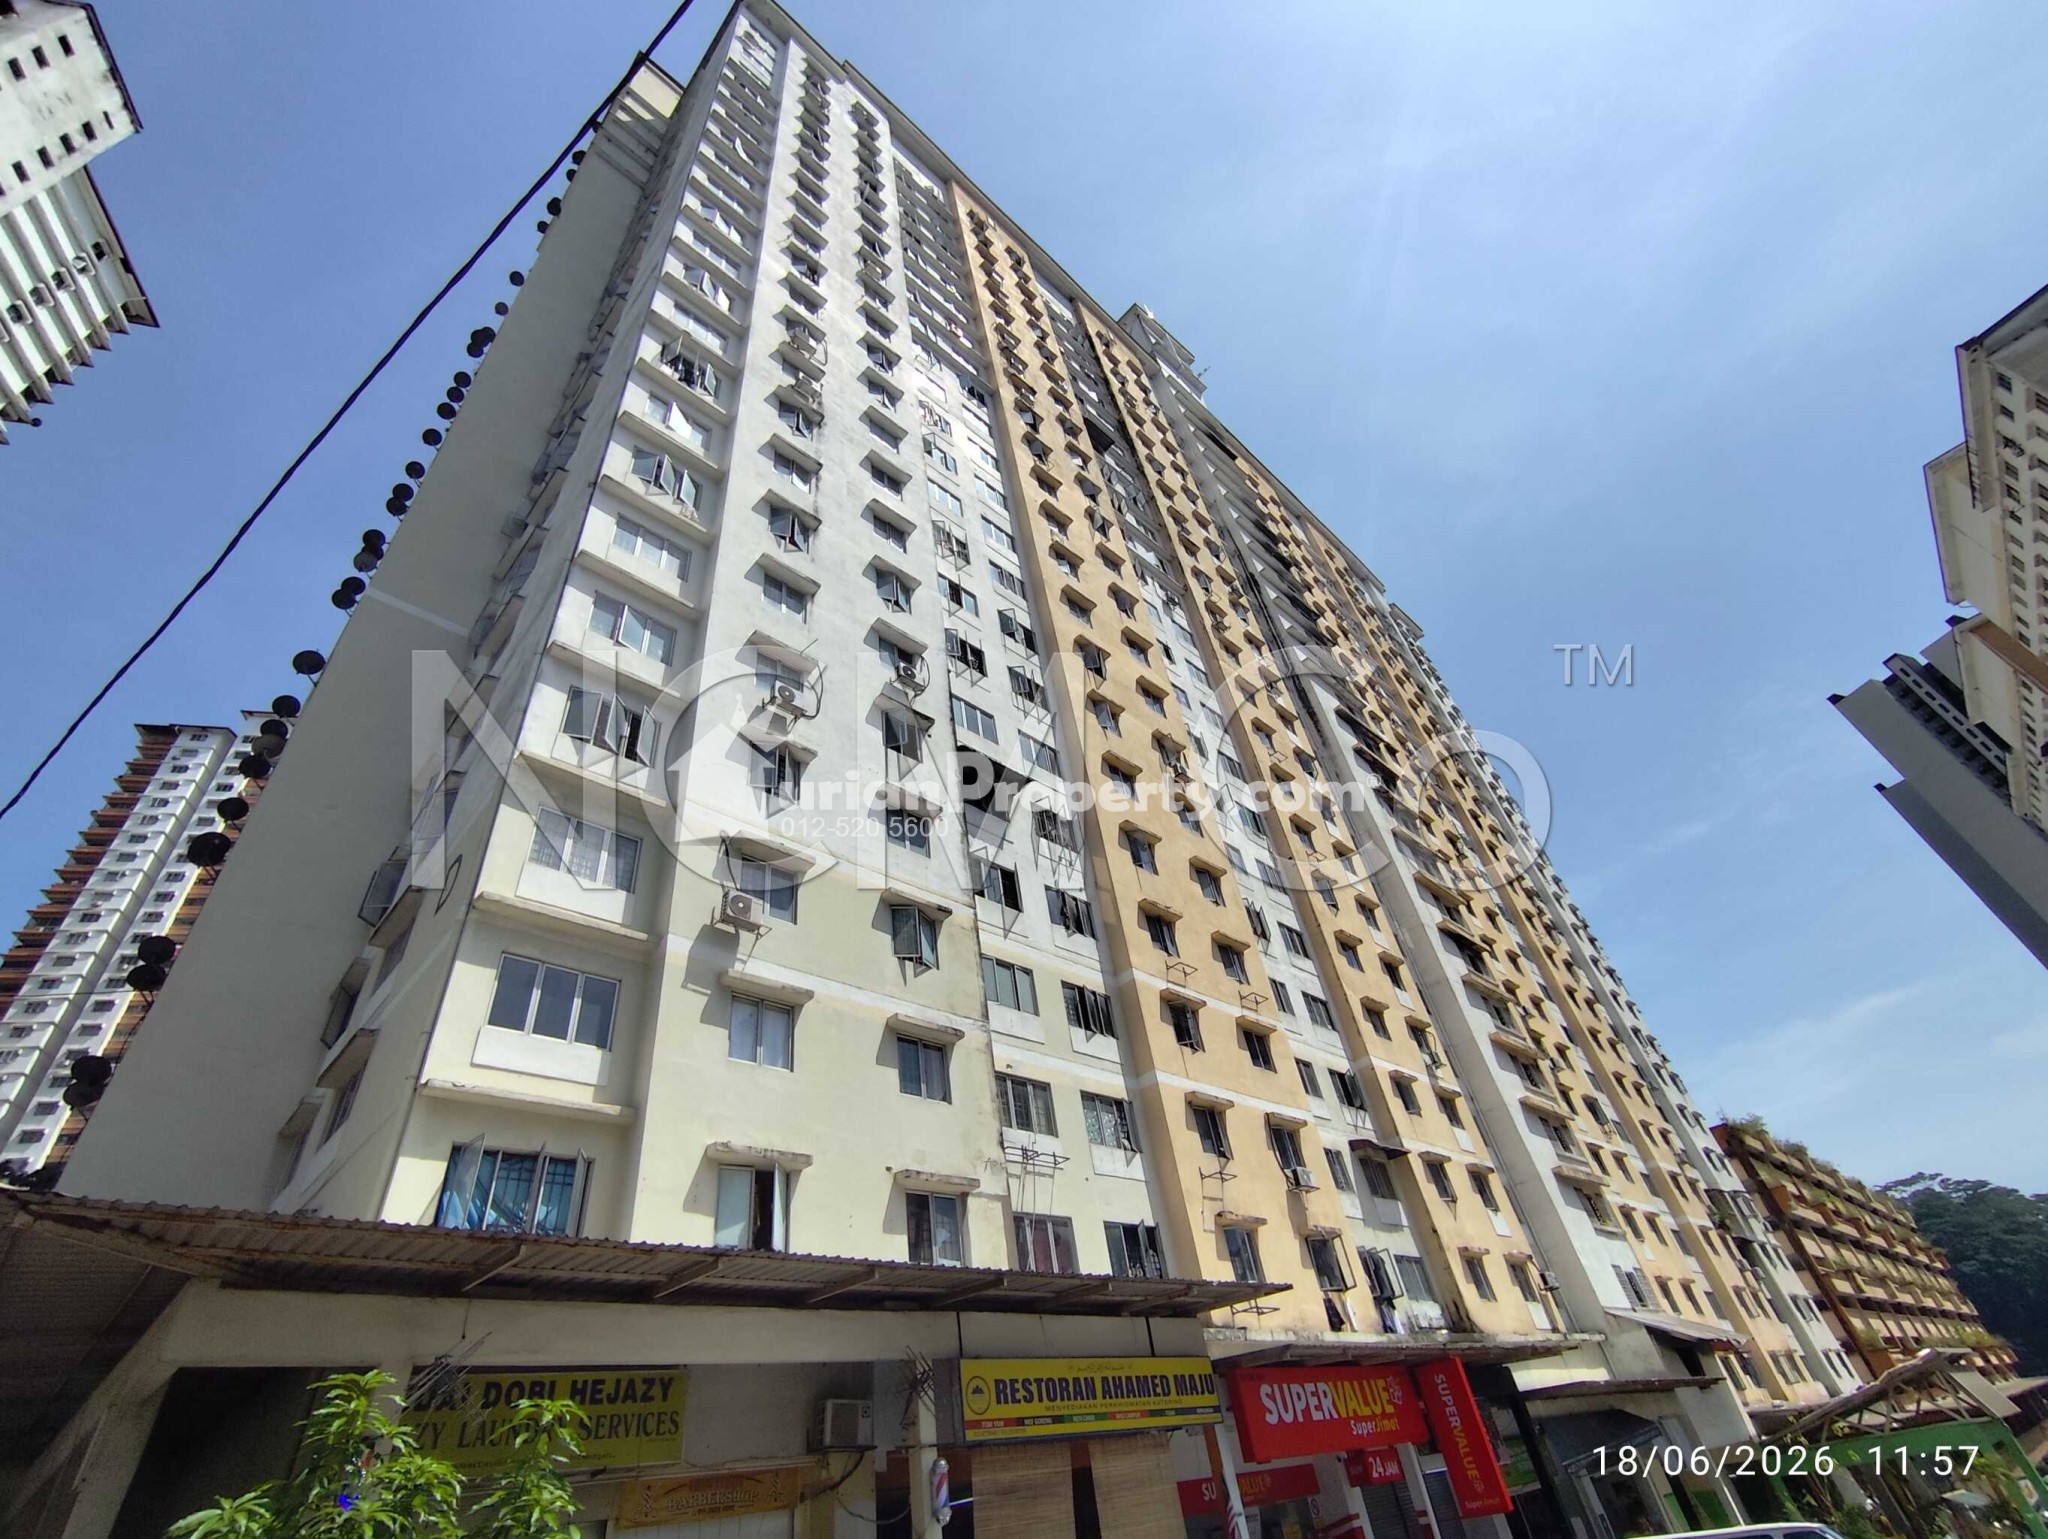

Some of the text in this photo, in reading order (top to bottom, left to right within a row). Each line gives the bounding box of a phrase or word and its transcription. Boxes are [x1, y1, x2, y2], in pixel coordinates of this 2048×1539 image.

[570, 1377, 674, 1404] HEJAZY
[994, 1377, 1097, 1405] RESTORAN
[1101, 1375, 1171, 1399] AHAMED
[1173, 1373, 1215, 1396] MAJU
[1259, 1378, 1395, 1425] SUPERVALUE
[579, 1410, 680, 1441] SERVICES
[1434, 1373, 1480, 1480] SUPERVALUE
[1368, 1456, 1384, 1478] 24
